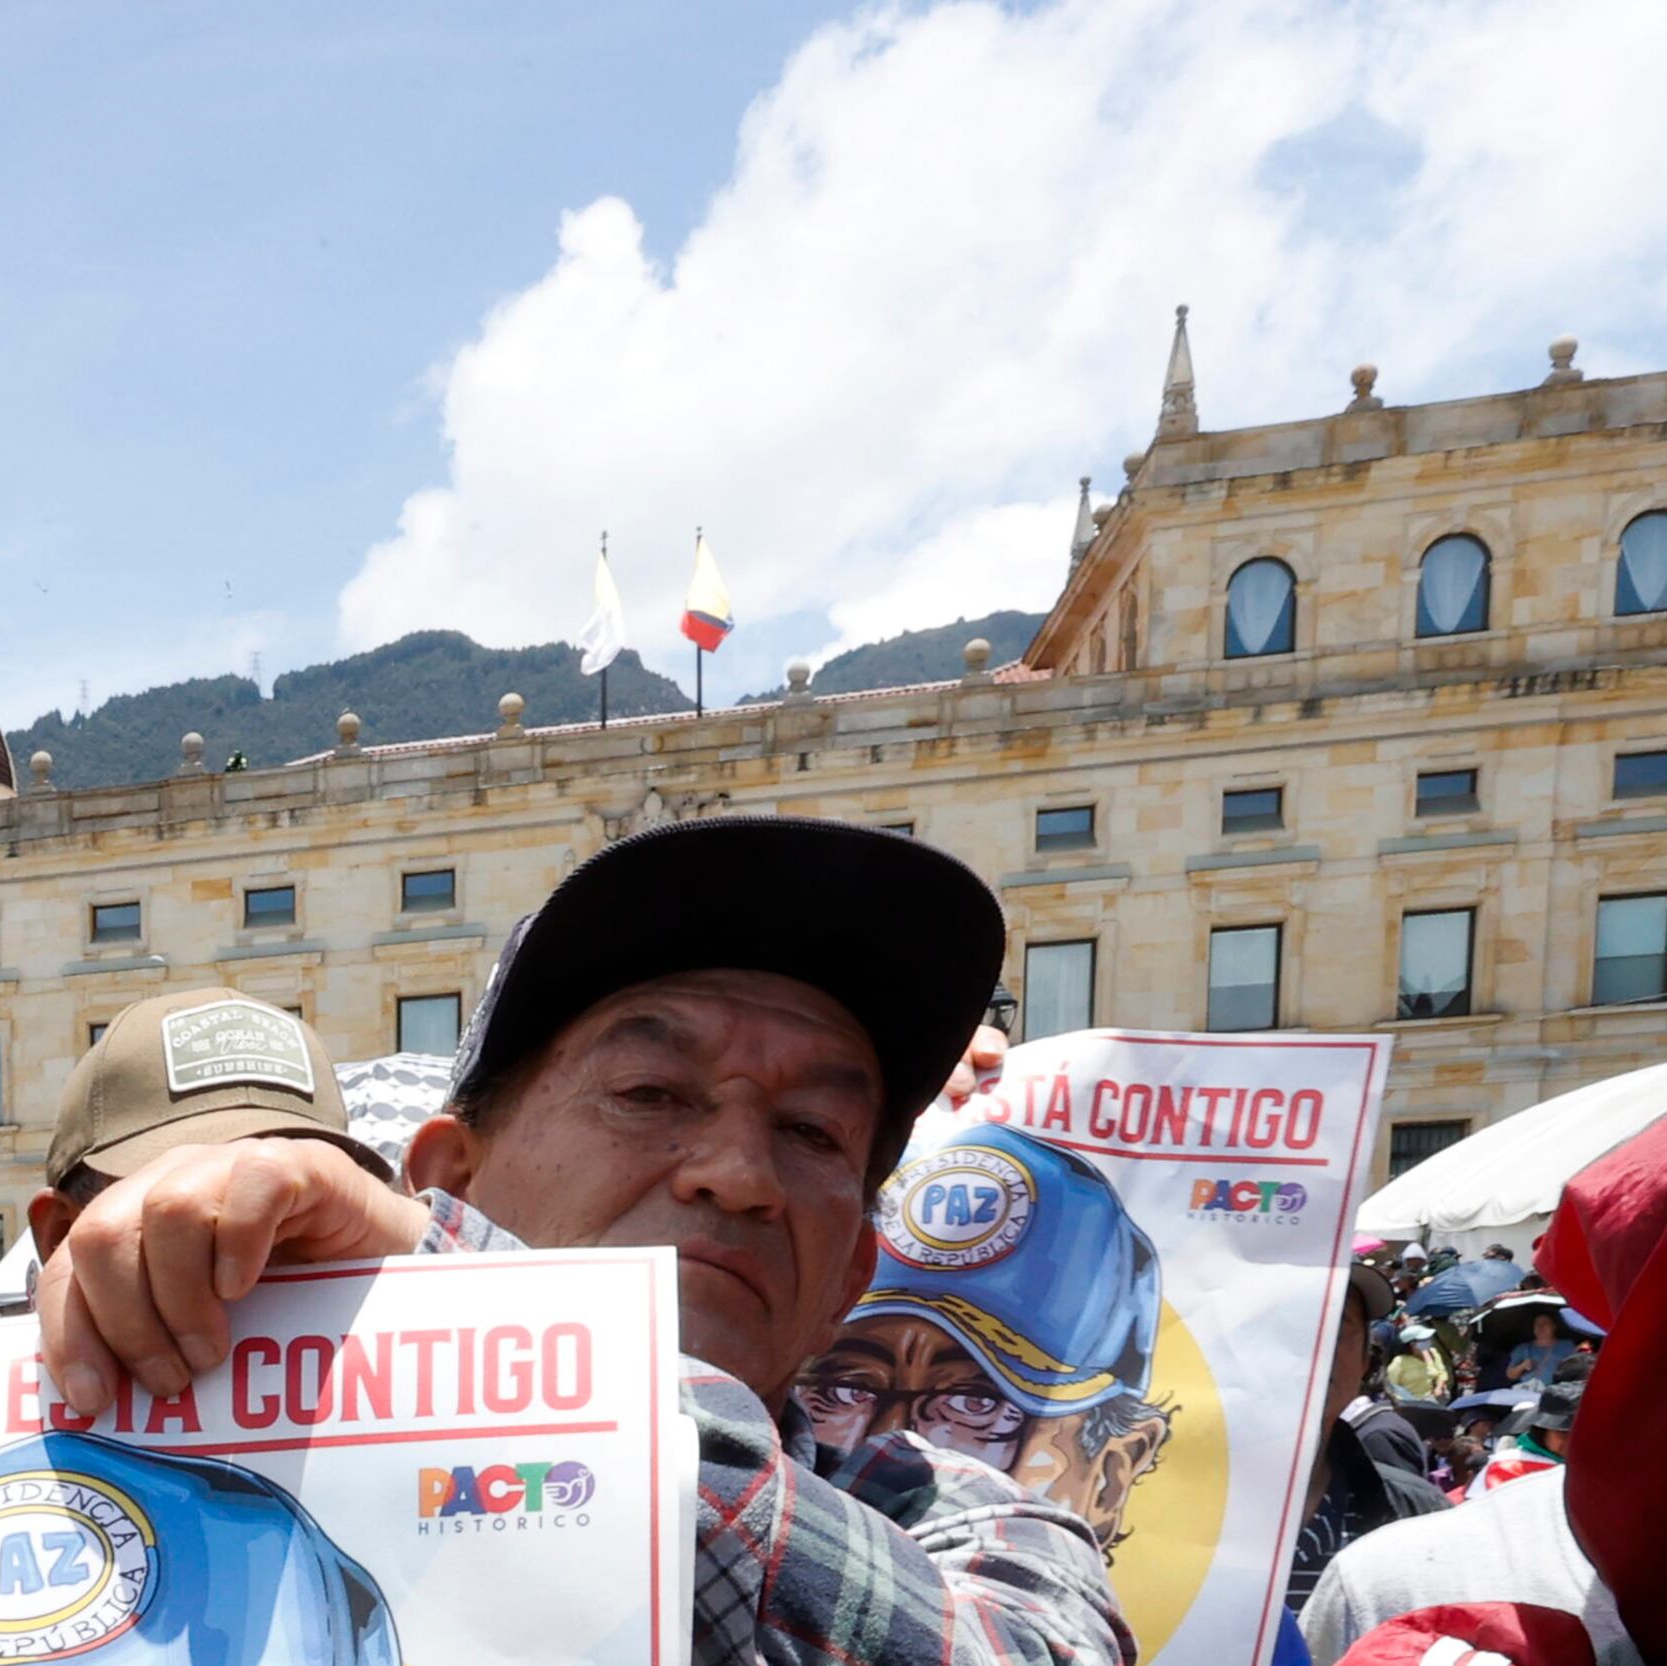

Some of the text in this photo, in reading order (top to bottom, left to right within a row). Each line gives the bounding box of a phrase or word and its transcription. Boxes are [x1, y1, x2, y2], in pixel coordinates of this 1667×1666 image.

[949, 1061, 1324, 1150] STÁ CONTIGO
[922, 1184, 1000, 1227] PAZ
[231, 1321, 593, 1429] CONTIGO
[418, 1460, 595, 1518] PACTO
